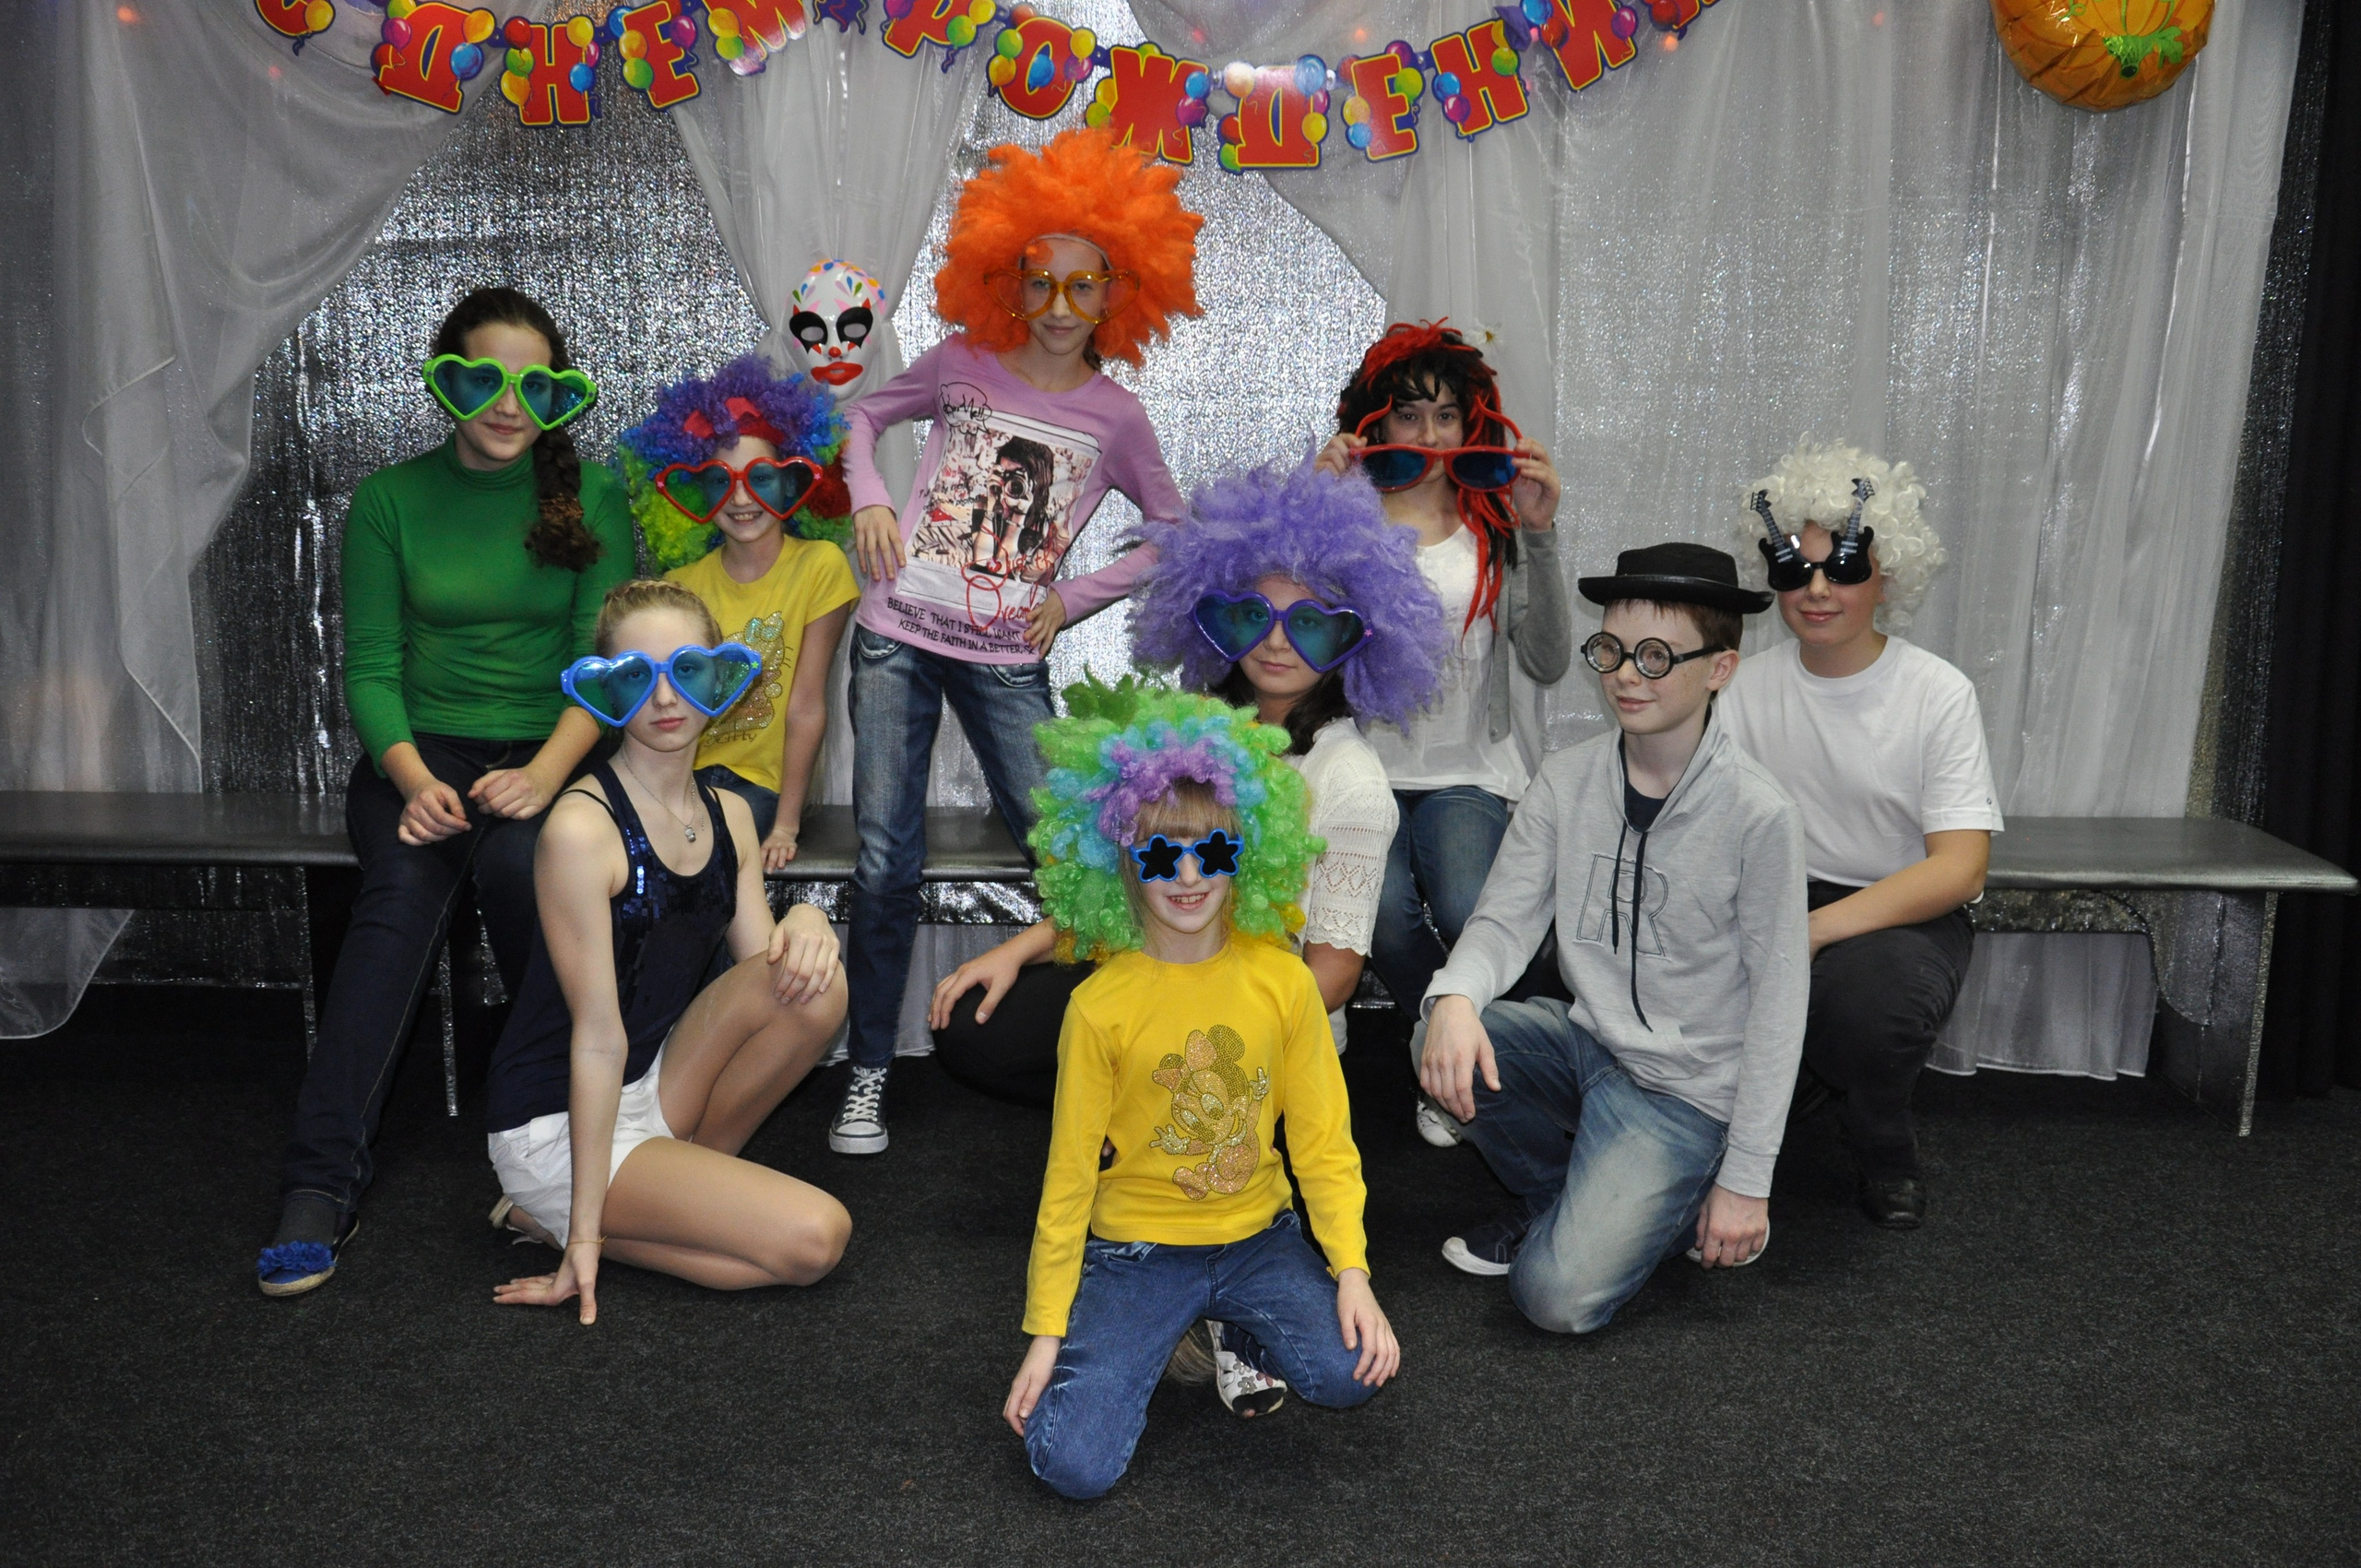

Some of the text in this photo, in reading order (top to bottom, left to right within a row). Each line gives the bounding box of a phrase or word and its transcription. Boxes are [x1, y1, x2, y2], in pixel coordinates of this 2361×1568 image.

[883, 0, 1721, 170] РОЖДЕНИ
[887, 597, 1021, 641] BELIEVE THAT I STILL WANT
[897, 618, 921, 635] KEEP
[922, 627, 940, 642] THE
[940, 633, 967, 649] FAITH
[967, 639, 979, 650] IN
[979, 641, 989, 652] A
[1575, 852, 1670, 957] R
